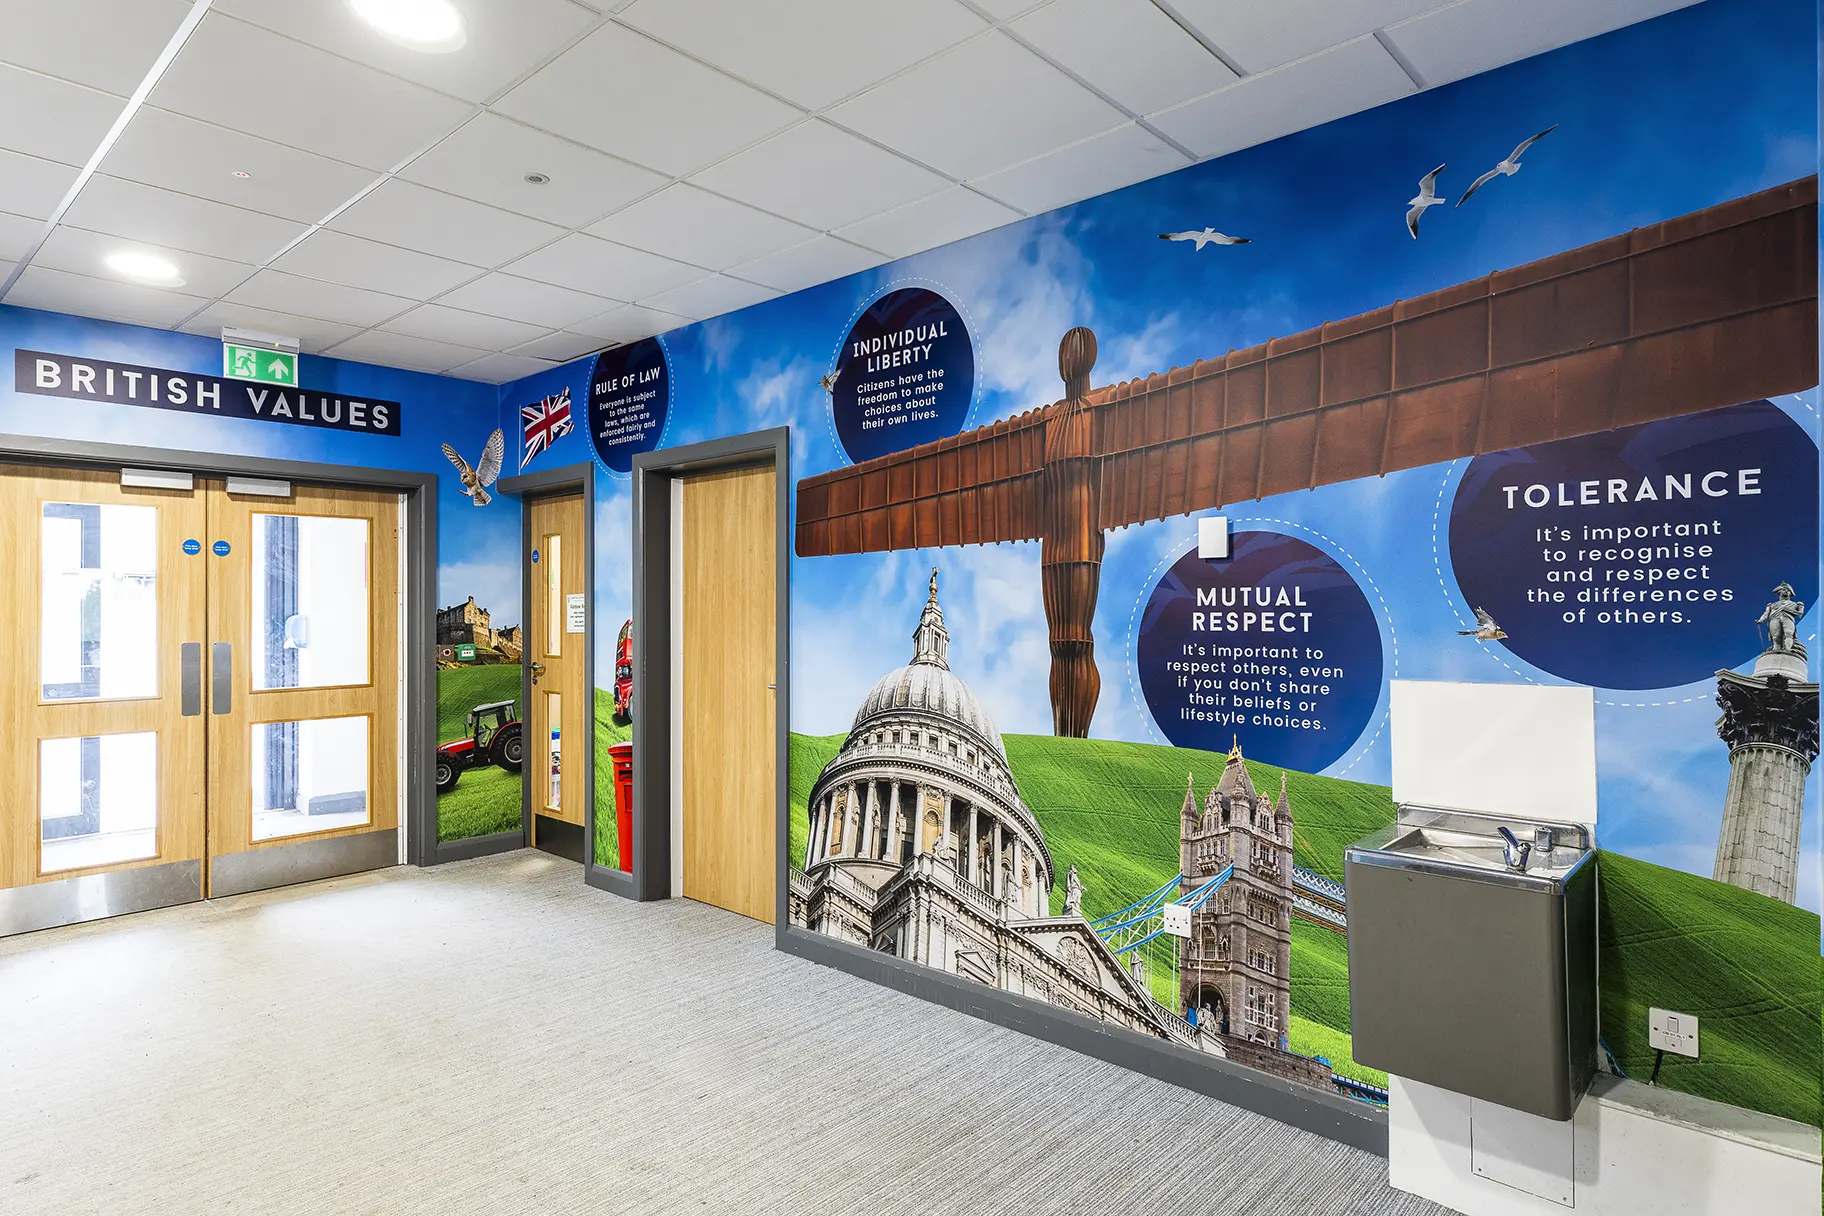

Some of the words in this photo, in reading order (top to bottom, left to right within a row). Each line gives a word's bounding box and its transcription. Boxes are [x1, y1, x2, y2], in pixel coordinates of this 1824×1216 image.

[853, 321, 947, 357] INDIVIDUAL
[867, 343, 932, 372] LIBERTY
[596, 379, 618, 395] RULE
[622, 374, 635, 387] OF
[640, 367, 660, 383] LAW
[857, 380, 895, 393] Citizens
[899, 374, 923, 385] have
[928, 369, 944, 379] the
[36, 359, 220, 409] BRITISH
[246, 387, 389, 429] VALUES
[600, 398, 625, 411] Everyone
[633, 390, 655, 402] subject
[857, 392, 898, 406] freedom
[902, 389, 911, 397] to
[916, 382, 943, 394] make
[628, 404, 644, 412] same
[865, 404, 901, 416] choices
[906, 396, 935, 409] about
[600, 425, 625, 438] enforced
[626, 423, 642, 432] fairly
[644, 420, 655, 428] and
[604, 419, 619, 428] laws,
[620, 415, 638, 424] which
[863, 418, 884, 429] their
[888, 416, 907, 425] own
[912, 411, 938, 421] lives.
[609, 433, 645, 445] consistently.
[1503, 469, 1761, 508] TOLERANCE
[1583, 520, 1721, 544] important
[1543, 549, 1566, 561] to
[1579, 543, 1712, 563] recognise
[1547, 568, 1592, 581] and
[1607, 565, 1709, 584] respect
[1197, 586, 1306, 606] MUTUAL
[1527, 589, 1565, 602] the
[1577, 588, 1733, 602] differences
[1193, 612, 1312, 632] RESPECT
[1563, 609, 1585, 622] of
[1598, 609, 1690, 623] others.
[1213, 645, 1297, 660] important
[1306, 648, 1323, 659] to
[1168, 662, 1225, 675] respect
[1233, 662, 1293, 677] others,
[1300, 667, 1344, 678] even
[1178, 676, 1187, 687] if
[1194, 679, 1221, 691] you
[1280, 681, 1329, 694] share
[1189, 693, 1225, 705] their
[1234, 695, 1290, 710] beliefs
[1299, 702, 1316, 711] or
[1181, 708, 1245, 726] lifestyle
[1253, 714, 1326, 730] choices.
